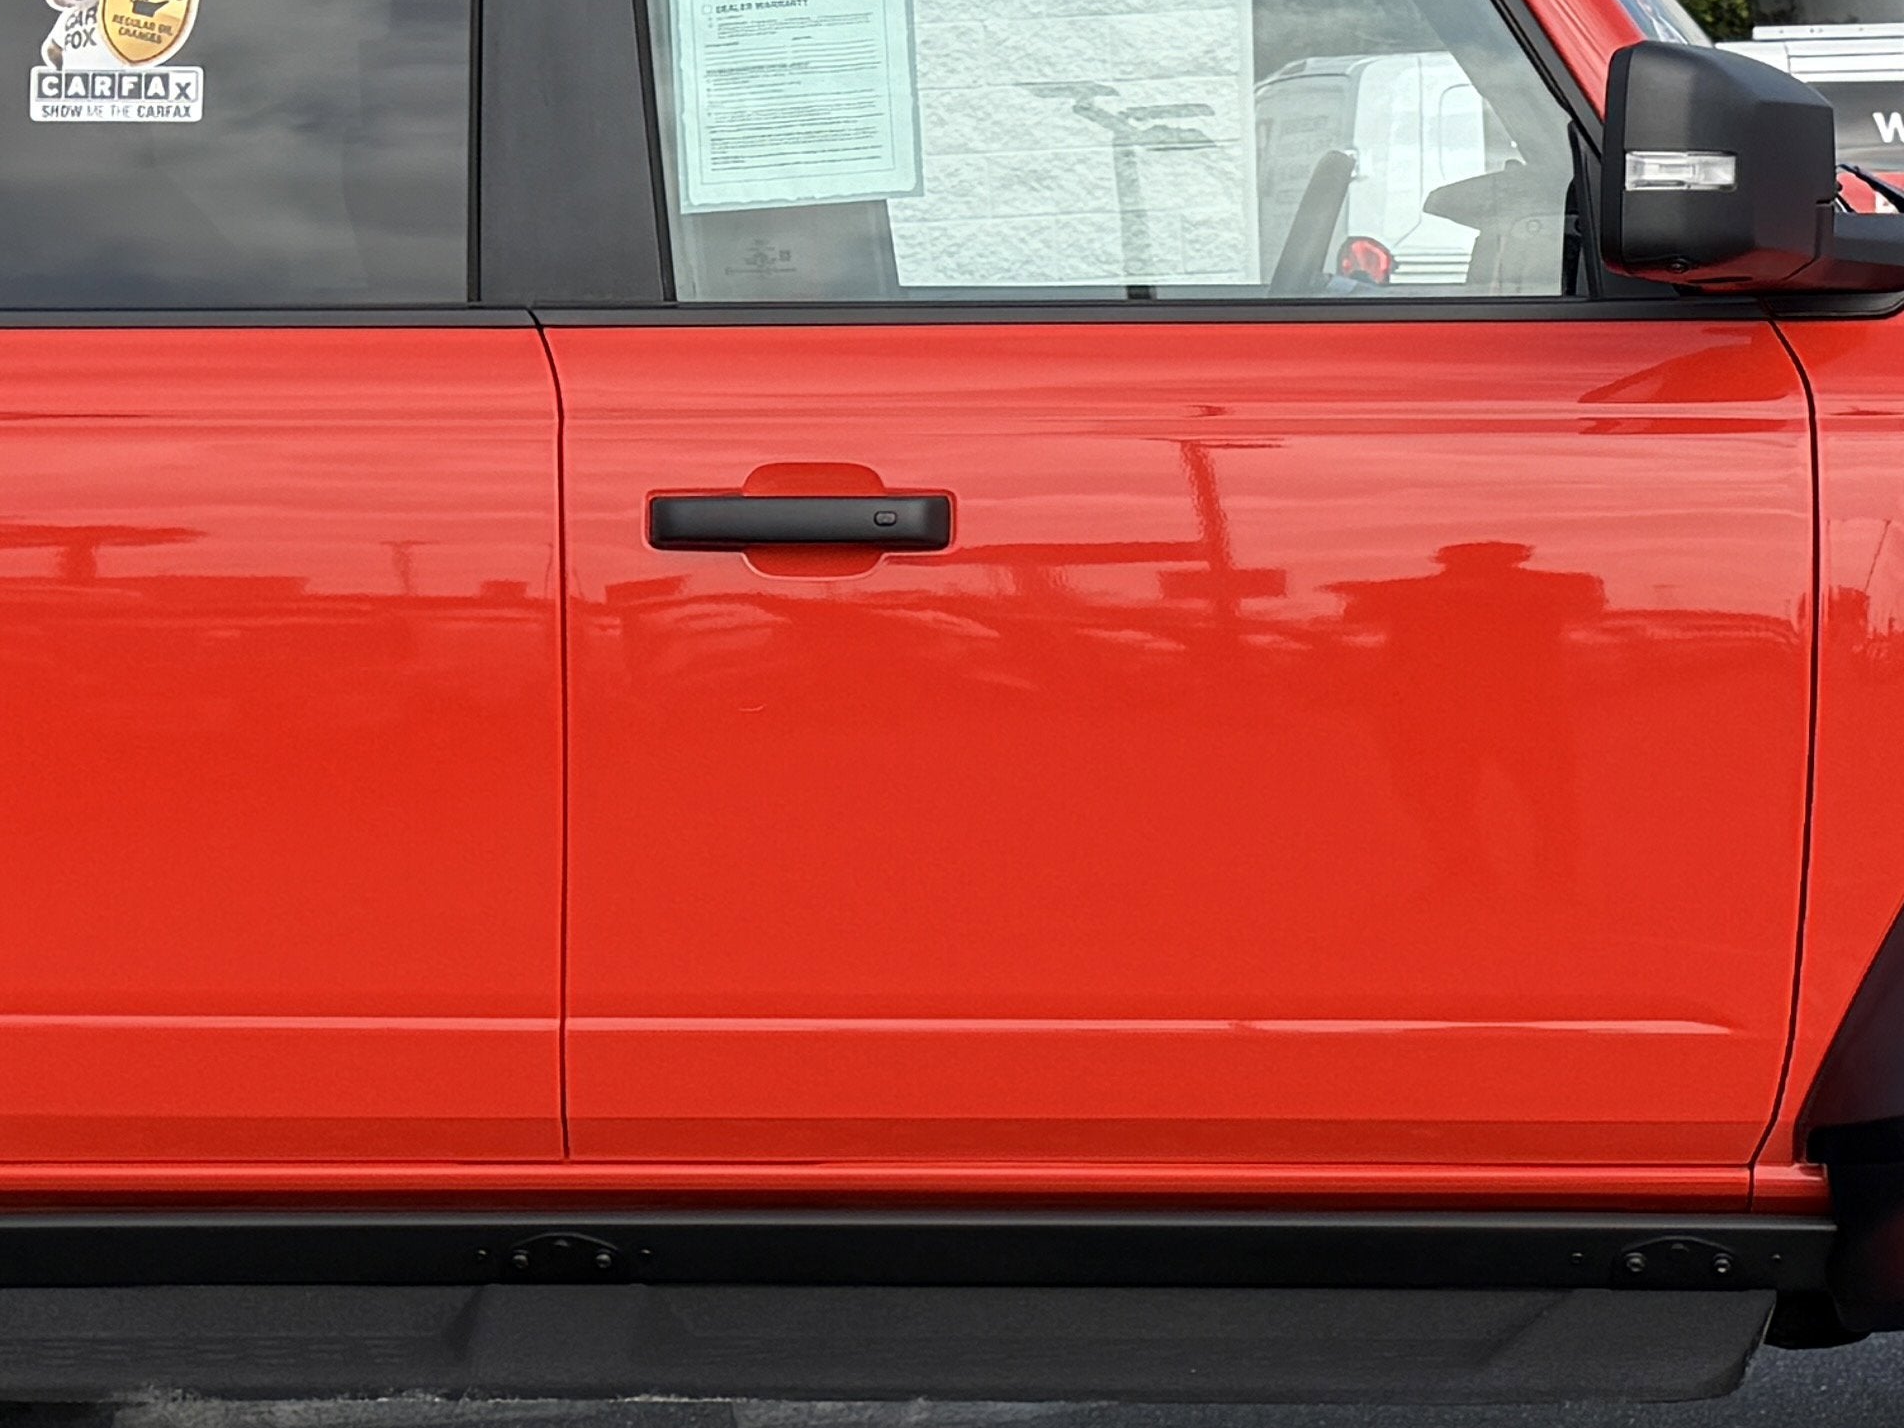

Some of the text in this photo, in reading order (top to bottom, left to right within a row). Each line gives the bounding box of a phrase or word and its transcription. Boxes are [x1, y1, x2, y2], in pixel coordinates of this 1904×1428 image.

[715, 1, 753, 14] DEALER
[64, 5, 97, 32] CAR
[111, 13, 156, 31] REGULAR
[64, 26, 98, 50] FOX
[39, 74, 194, 101] CARFAX
[41, 104, 193, 119] SHOW ME THE CARFAX
